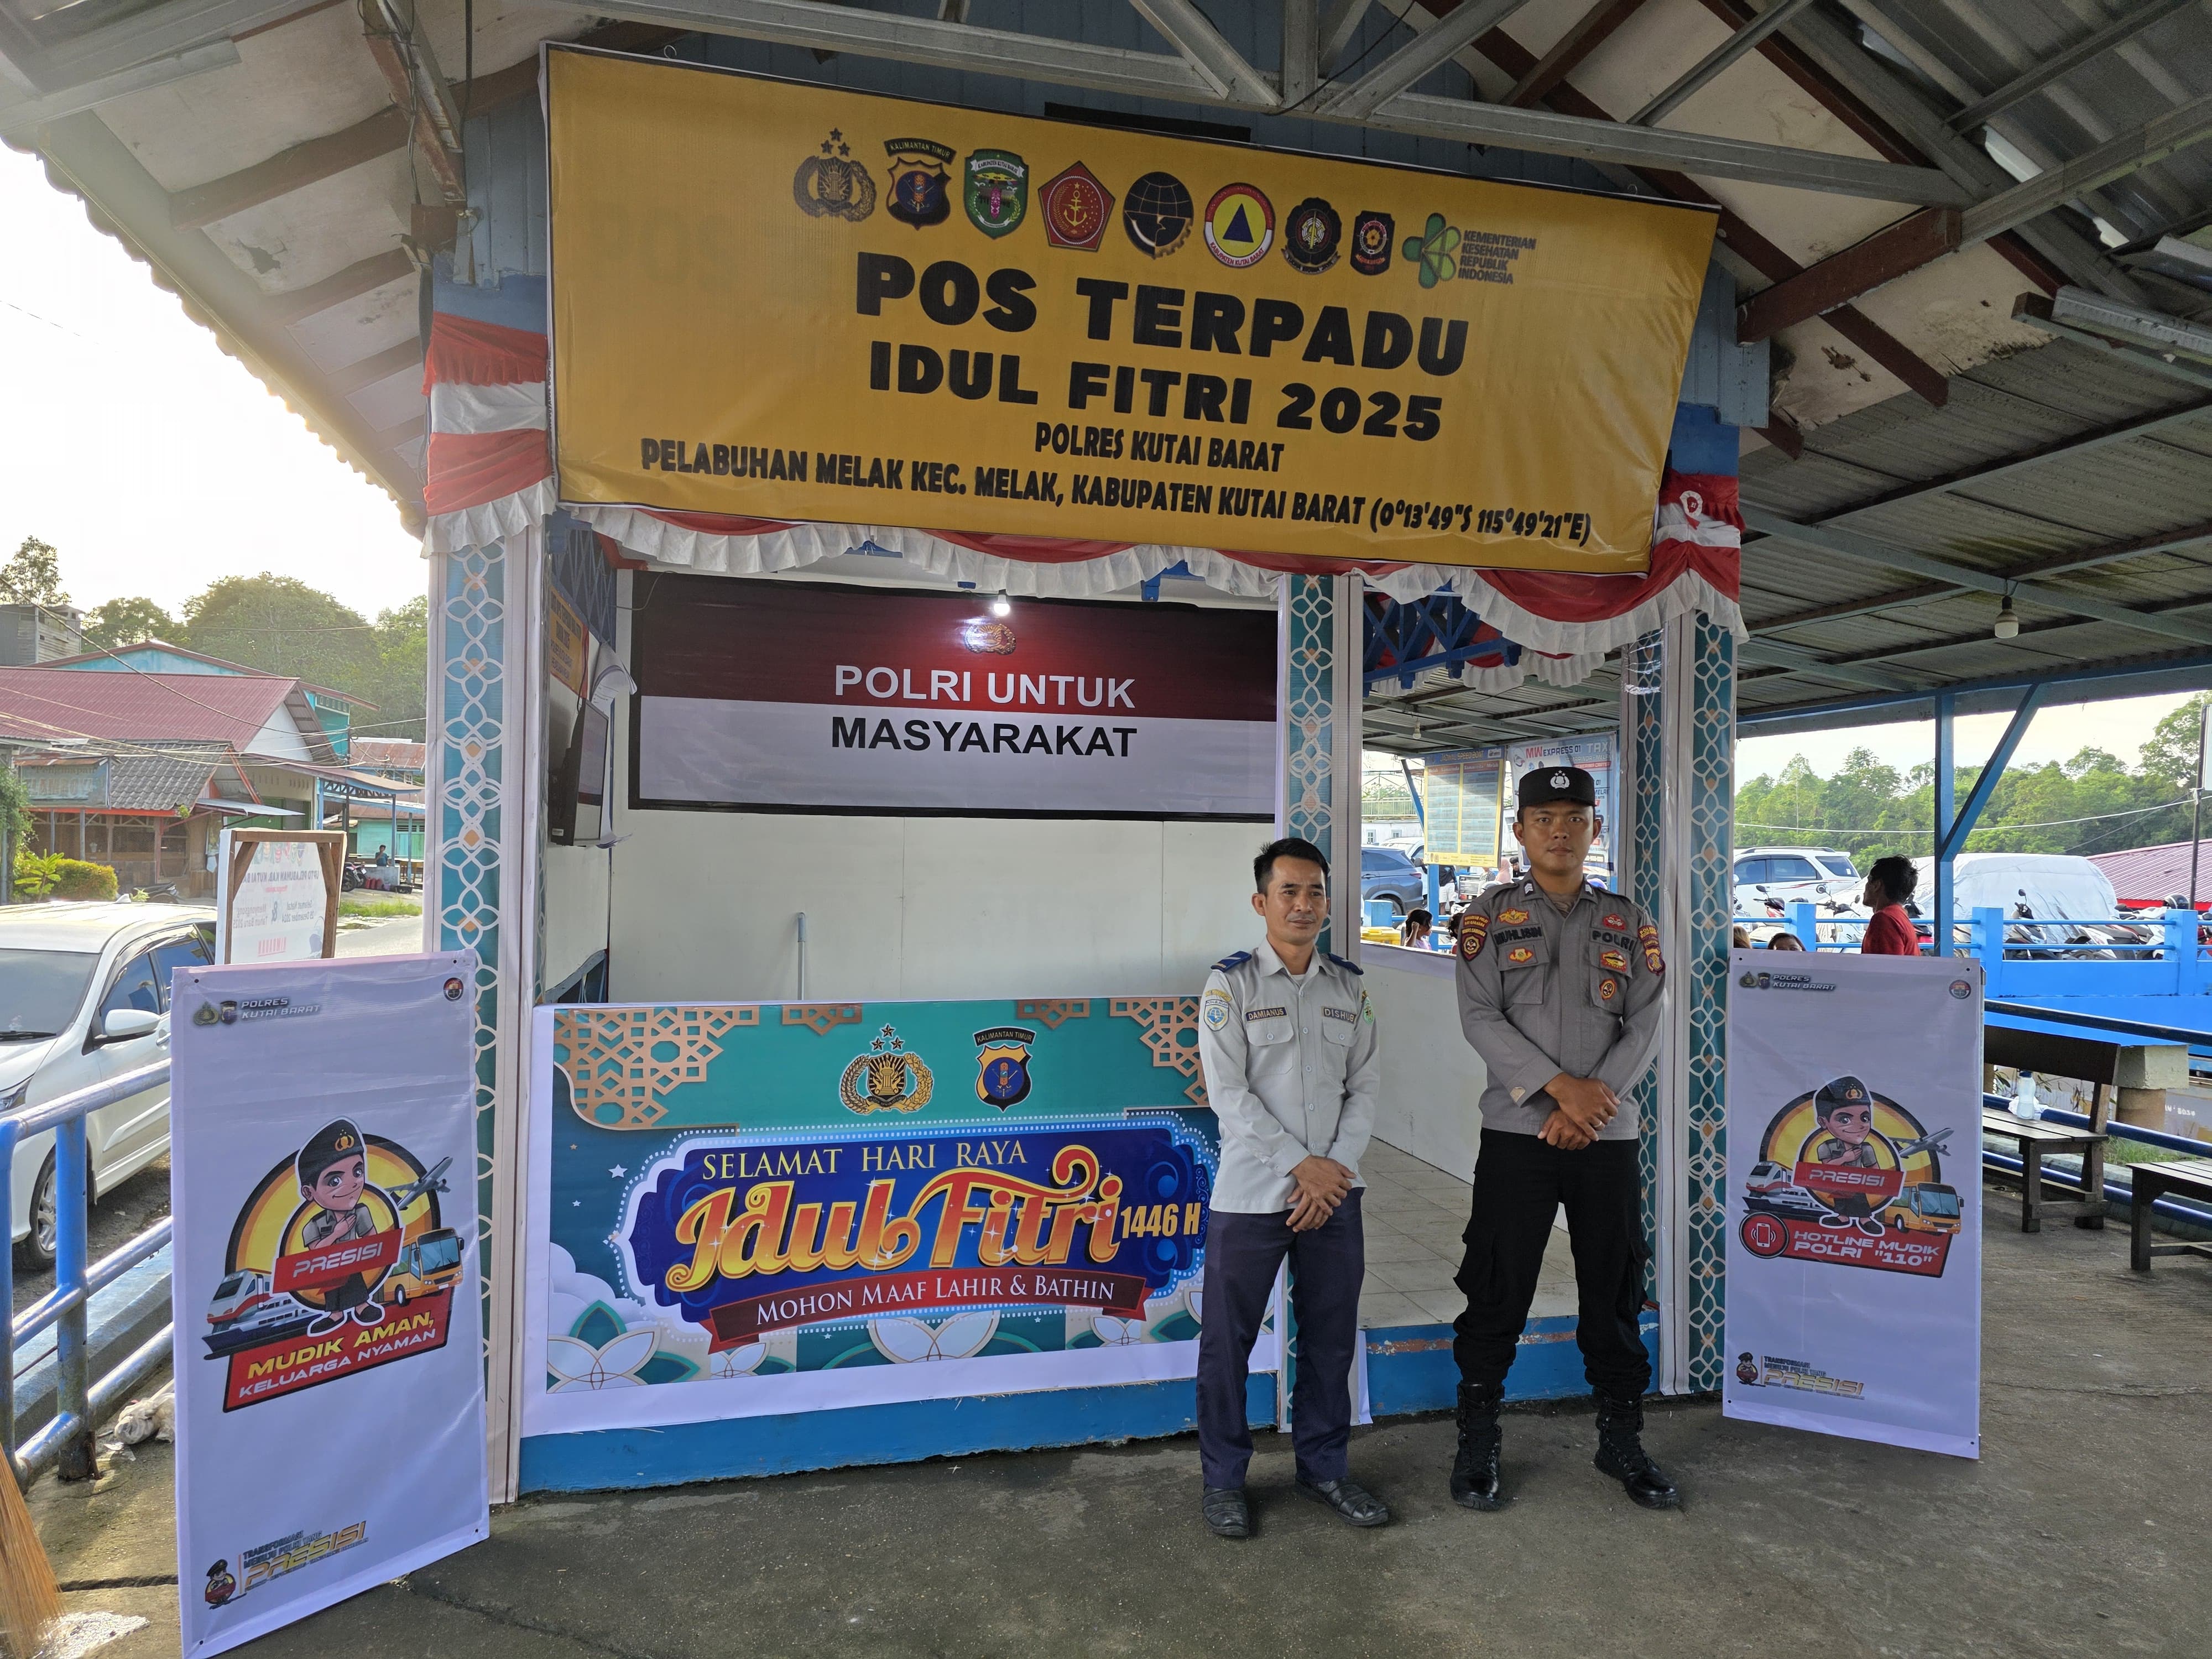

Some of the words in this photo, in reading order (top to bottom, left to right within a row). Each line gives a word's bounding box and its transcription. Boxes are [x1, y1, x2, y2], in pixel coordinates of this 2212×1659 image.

[890, 141, 930, 151] KALIMANTAN
[931, 145, 951, 158] TIMUR
[1210, 242, 1234, 264] KABUPATEN
[1250, 248, 1265, 262] BARAT
[1461, 242, 1520, 260] KESEHATAN
[1463, 230, 1537, 250] KEMENTERIAN
[1459, 255, 1509, 271] REPUBLIK
[1458, 268, 1514, 285] INDONESIA
[857, 252, 1037, 332] POS
[1076, 277, 1469, 377] TERPADU
[870, 341, 1039, 405] IDUL
[1068, 361, 1252, 425] FITRI
[1276, 383, 1443, 442] 2025
[1035, 422, 1124, 460] POLRES
[1130, 431, 1202, 466] KUTAI
[1207, 437, 1285, 473] BARAT
[641, 437, 808, 482] PELABUHAN
[815, 452, 904, 490] MELAK
[911, 461, 967, 496] KEC.
[974, 466, 1065, 508] MELAK,
[1071, 474, 1213, 514] KABUPATEN
[1217, 486, 1287, 520] KUTAI
[1291, 492, 1366, 525] BARAT
[835, 665, 971, 702] POLRI
[988, 672, 1136, 709] UNTUK
[832, 716, 1138, 757] MASYARAKAT
[1457, 752, 1472, 760] SPEED
[1526, 747, 1543, 759] MW
[1543, 746, 1573, 757] EXPRESS
[1592, 930, 1636, 952] POLRI
[241, 998, 288, 1008] POLRES
[242, 1009, 276, 1019] KUTAI
[281, 1005, 320, 1015] BARAT
[1248, 1008, 1284, 1020] DAMIANUS
[1324, 1008, 1354, 1022] DISHUB
[977, 1031, 1014, 1043] KALIMANTAN
[1015, 1031, 1032, 1042] TIMUR
[702, 1148, 843, 1181] SELAMAT
[861, 1144, 936, 1172] HARI
[956, 1139, 1029, 1167] RAYA
[1809, 1168, 1885, 1188] PRESISI
[665, 1178, 921, 1292] Idul
[910, 1144, 1123, 1269] Fitri
[1120, 1202, 1178, 1239] 1446
[1183, 1202, 1202, 1235] H
[1793, 1230, 1873, 1249] HOTLINE
[1879, 1240, 1940, 1256] MUDIK
[1793, 1242, 1862, 1259] POLRI
[1874, 1249, 1933, 1266] "110"
[293, 1241, 383, 1279] PRESISI
[757, 1289, 853, 1326] MOHON
[861, 1281, 926, 1306] MAAF
[935, 1277, 1003, 1299] LAHIR
[1009, 1274, 1027, 1295] &
[1034, 1275, 1115, 1301] BATHIN
[247, 1337, 344, 1379] MUDIK
[353, 1311, 435, 1348] AMAN,
[239, 1356, 351, 1399] KELUARGA
[357, 1328, 436, 1362] NYAMAN
[1764, 1369, 1865, 1395] PRESISI
[244, 1520, 367, 1589] PRESISI
